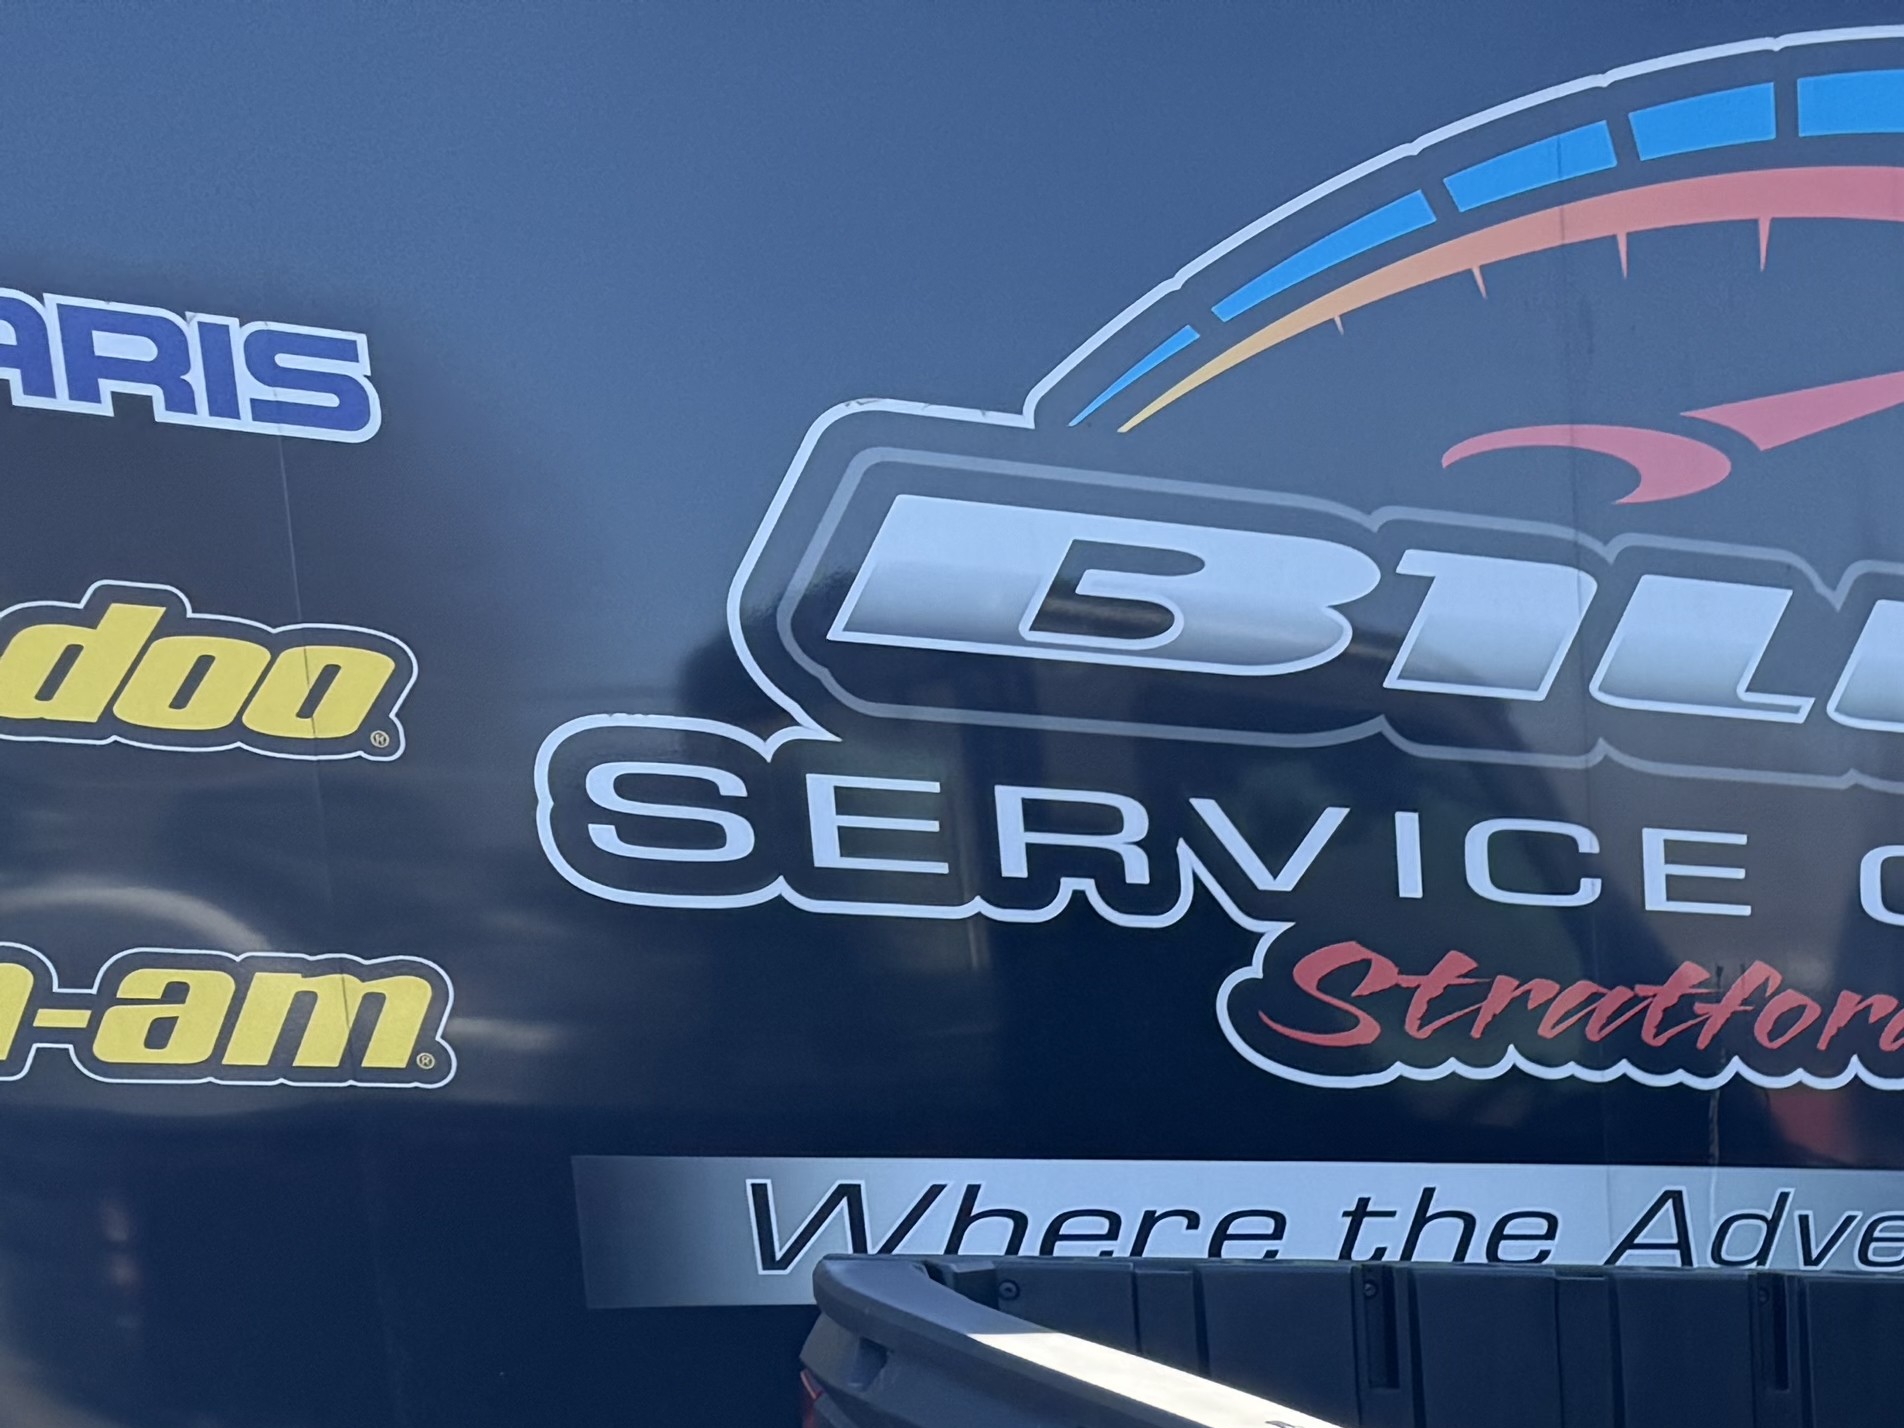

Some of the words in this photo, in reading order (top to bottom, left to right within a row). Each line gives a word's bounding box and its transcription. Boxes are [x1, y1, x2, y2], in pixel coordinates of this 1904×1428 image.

[585, 761, 1751, 916] SERVICE
[746, 1178, 1288, 1275] Where
[1336, 1186, 1561, 1264] the
